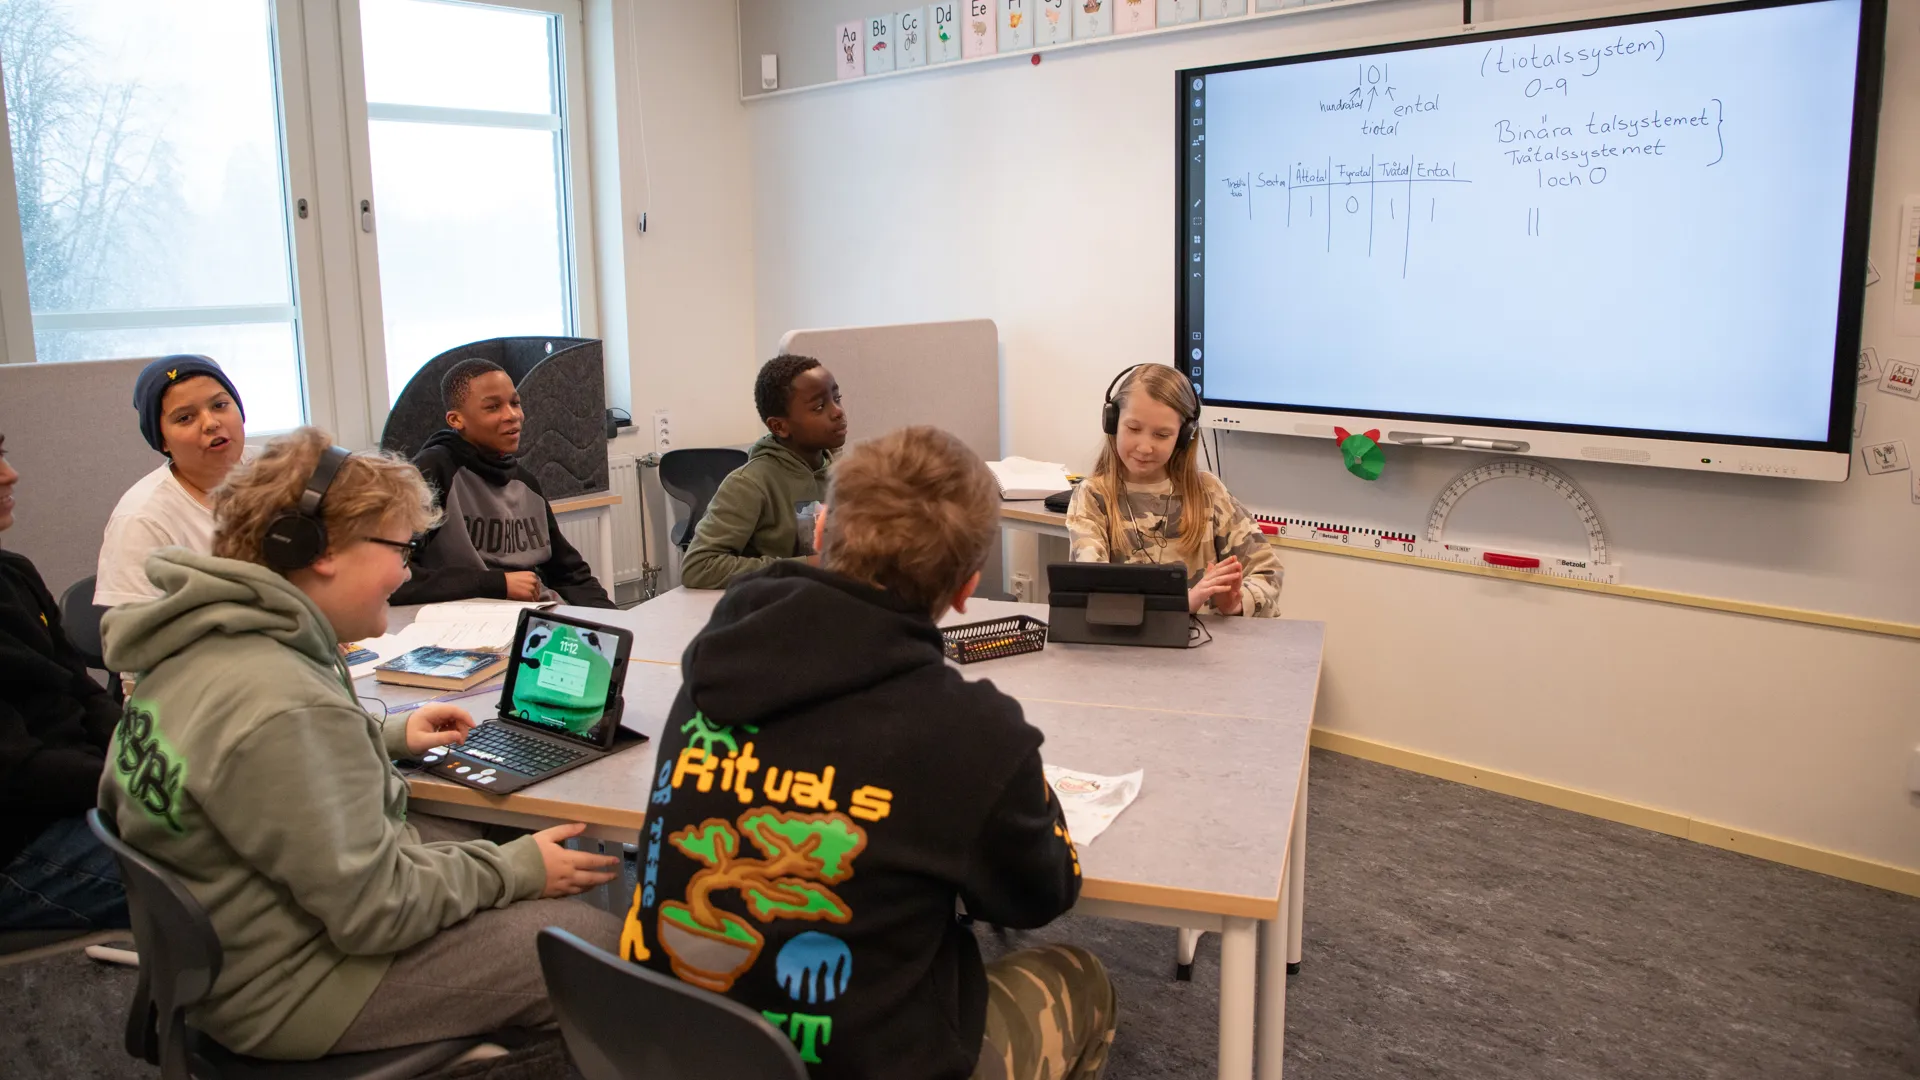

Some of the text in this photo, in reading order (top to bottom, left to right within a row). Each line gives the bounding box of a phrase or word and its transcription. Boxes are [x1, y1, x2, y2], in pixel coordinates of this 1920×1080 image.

[936, 6, 952, 24] Dd
[971, 0, 986, 17] Ee
[872, 20, 886, 37] Bb
[902, 13, 917, 31] Cc
[842, 28, 856, 42] Aa
[1359, 63, 1388, 86] 101
[1525, 78, 1567, 98] 0-9
[1319, 98, 1363, 113] hundratal
[1394, 94, 1439, 117] ental
[1361, 119, 1399, 136] tiotal
[1495, 108, 1709, 143] Binära talsystemet
[1504, 138, 1665, 168] Tvåtalssystemet
[1335, 164, 1371, 185] Fyratal
[1378, 161, 1409, 177] Tvåtal
[1417, 161, 1455, 178] Ental
[1547, 171, 1582, 187] och
[1280, 526, 1286, 535] 6
[1311, 530, 1317, 539] 7
[1341, 535, 1348, 544] 8
[1374, 539, 1381, 548] 9
[1402, 543, 1414, 553] 10
[1561, 559, 1586, 569] Betzold
[560, 640, 579, 655] 11:12
